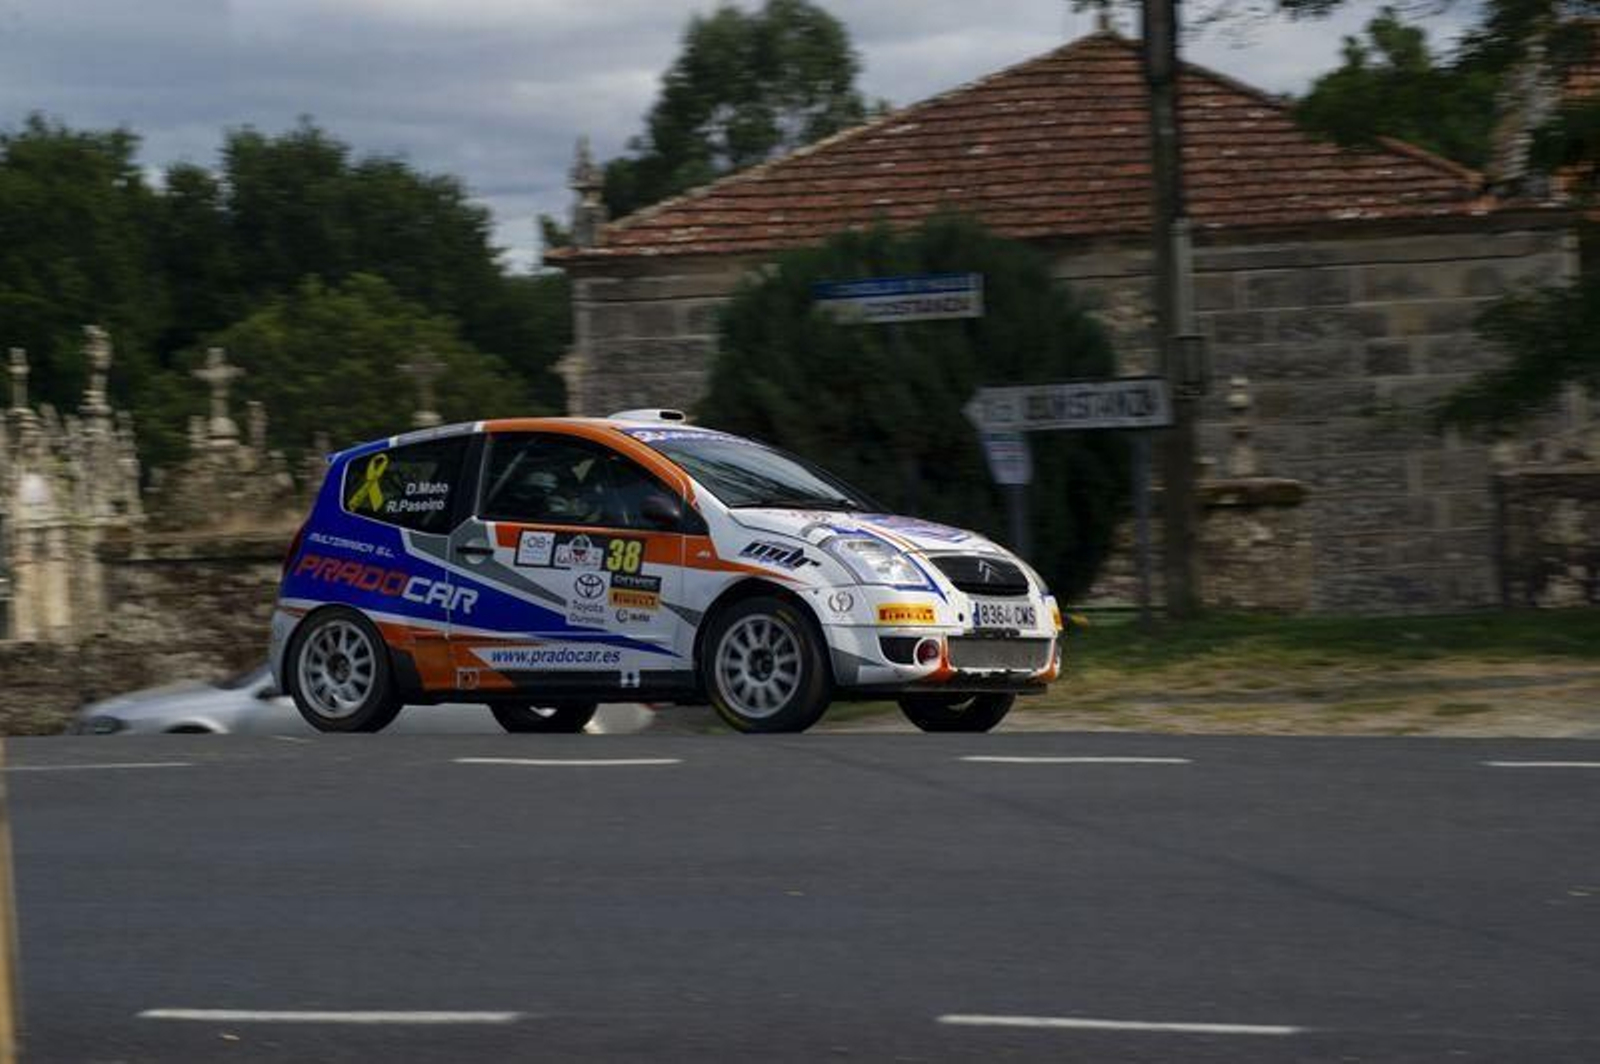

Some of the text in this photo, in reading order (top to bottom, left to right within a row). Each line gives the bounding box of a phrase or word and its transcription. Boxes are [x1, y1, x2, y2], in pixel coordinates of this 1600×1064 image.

[405, 482, 449, 496] D.Mato
[386, 499, 445, 512] R.Paseiro
[606, 539, 642, 573] 38
[295, 554, 479, 614] PRADOCAR
[572, 599, 604, 613] Toyota
[491, 648, 620, 666] www.pradocar.es
